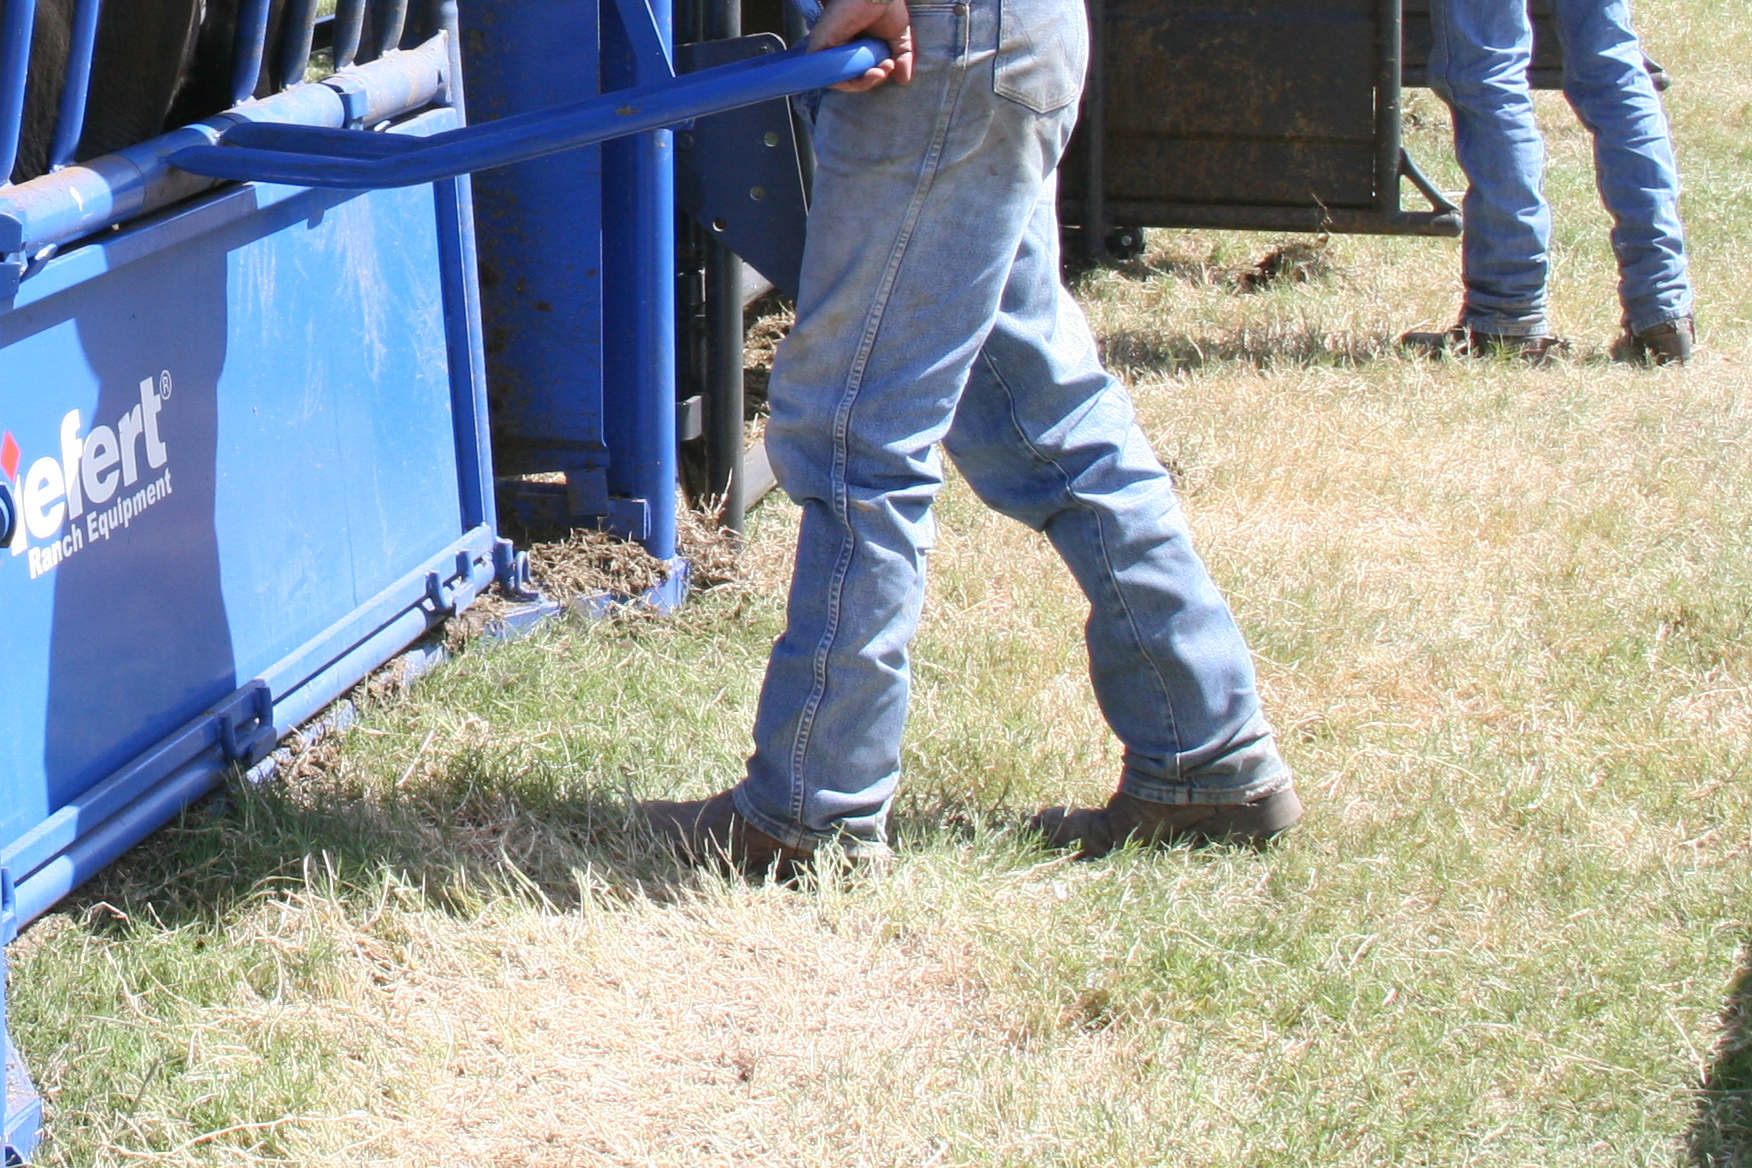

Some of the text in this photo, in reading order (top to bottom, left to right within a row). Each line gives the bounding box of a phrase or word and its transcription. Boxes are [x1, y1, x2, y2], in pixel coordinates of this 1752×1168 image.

[4, 376, 168, 558] iefert
[28, 467, 173, 580] Ranch Equipment
